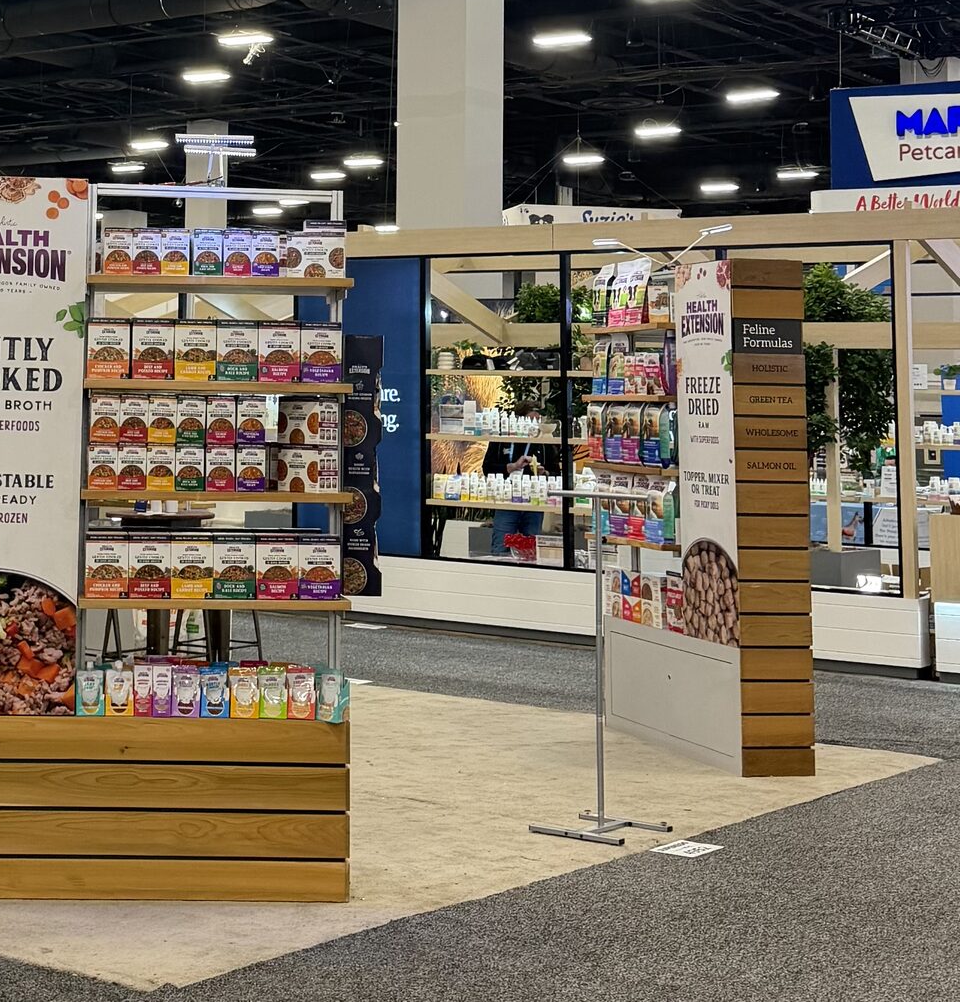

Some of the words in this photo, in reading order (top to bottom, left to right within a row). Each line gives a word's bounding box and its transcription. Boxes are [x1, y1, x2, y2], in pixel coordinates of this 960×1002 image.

[686, 299, 718, 314] HEALTH
[743, 323, 776, 336] Feline
[743, 337, 793, 349] Formulas
[751, 364, 788, 373] HOLISTIC
[685, 376, 721, 395] FREEZE
[4, 400, 52, 411] BROTH
[749, 395, 776, 404] GREEN
[777, 395, 793, 404] TEA
[688, 398, 719, 416] DRIED
[698, 421, 709, 429] RAW
[745, 428, 798, 438] WHOLESOME
[747, 461, 781, 470] SALMON
[783, 461, 797, 471] OIL
[708, 472, 730, 485] MIXER
[691, 484, 700, 496] OR
[701, 484, 720, 497] TREAT
